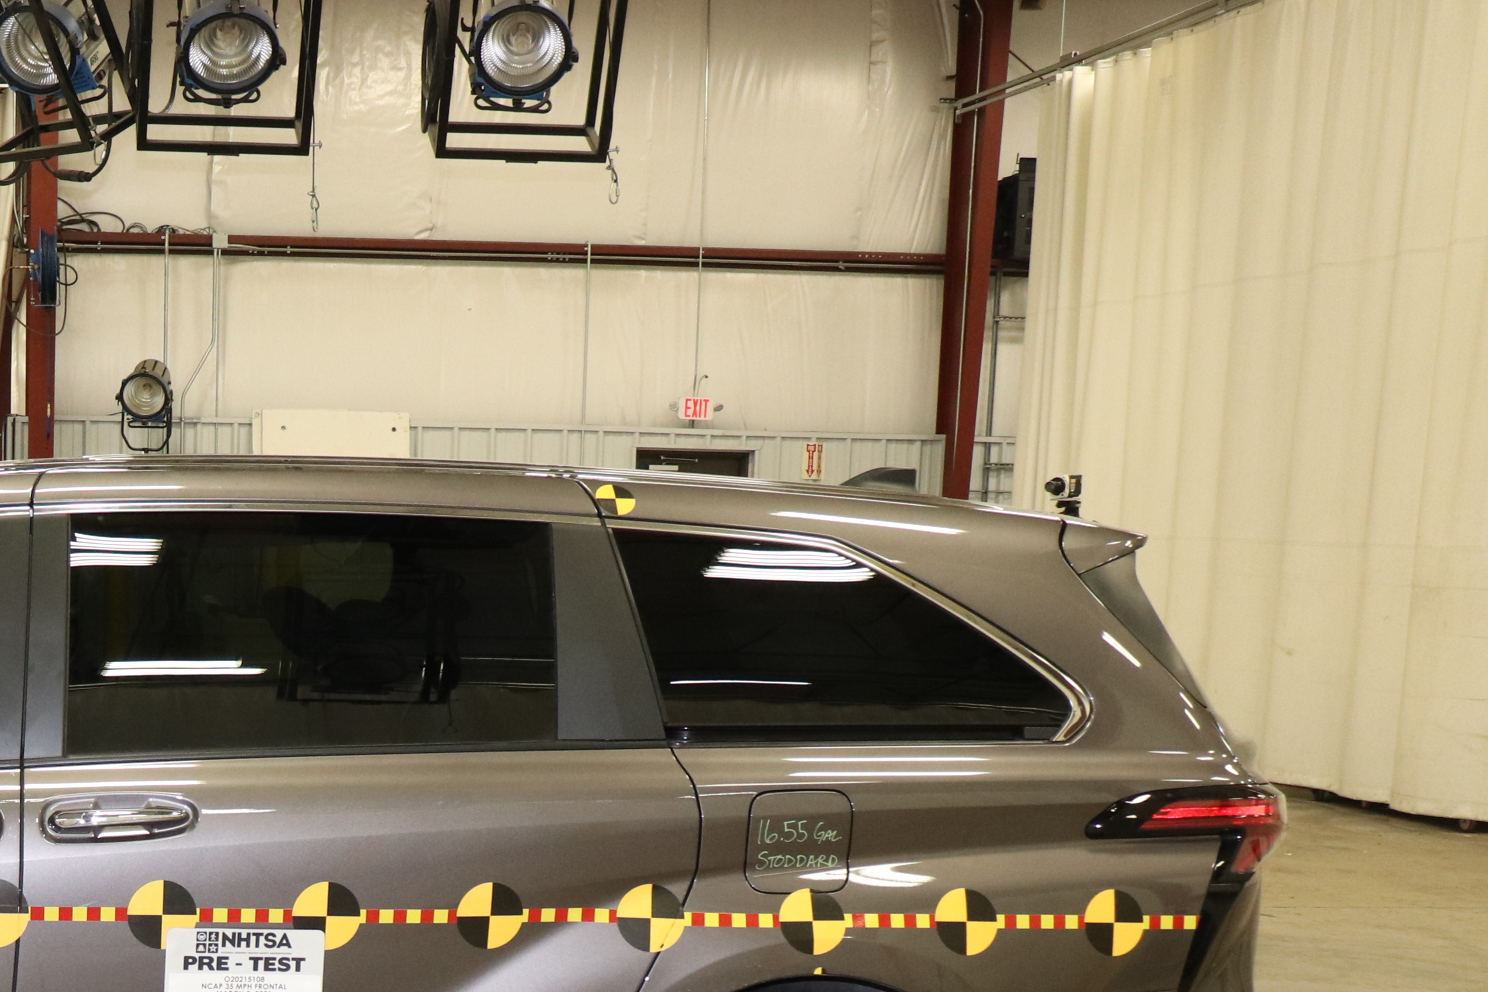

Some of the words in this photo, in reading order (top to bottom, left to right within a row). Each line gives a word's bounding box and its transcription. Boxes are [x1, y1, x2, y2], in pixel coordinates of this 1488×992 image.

[684, 398, 710, 419] EXIT
[757, 819, 808, 844] 16.55
[755, 850, 839, 870] STODDARD
[221, 932, 292, 949] NHTSA
[183, 956, 229, 971] PRE
[249, 957, 306, 972] TEST
